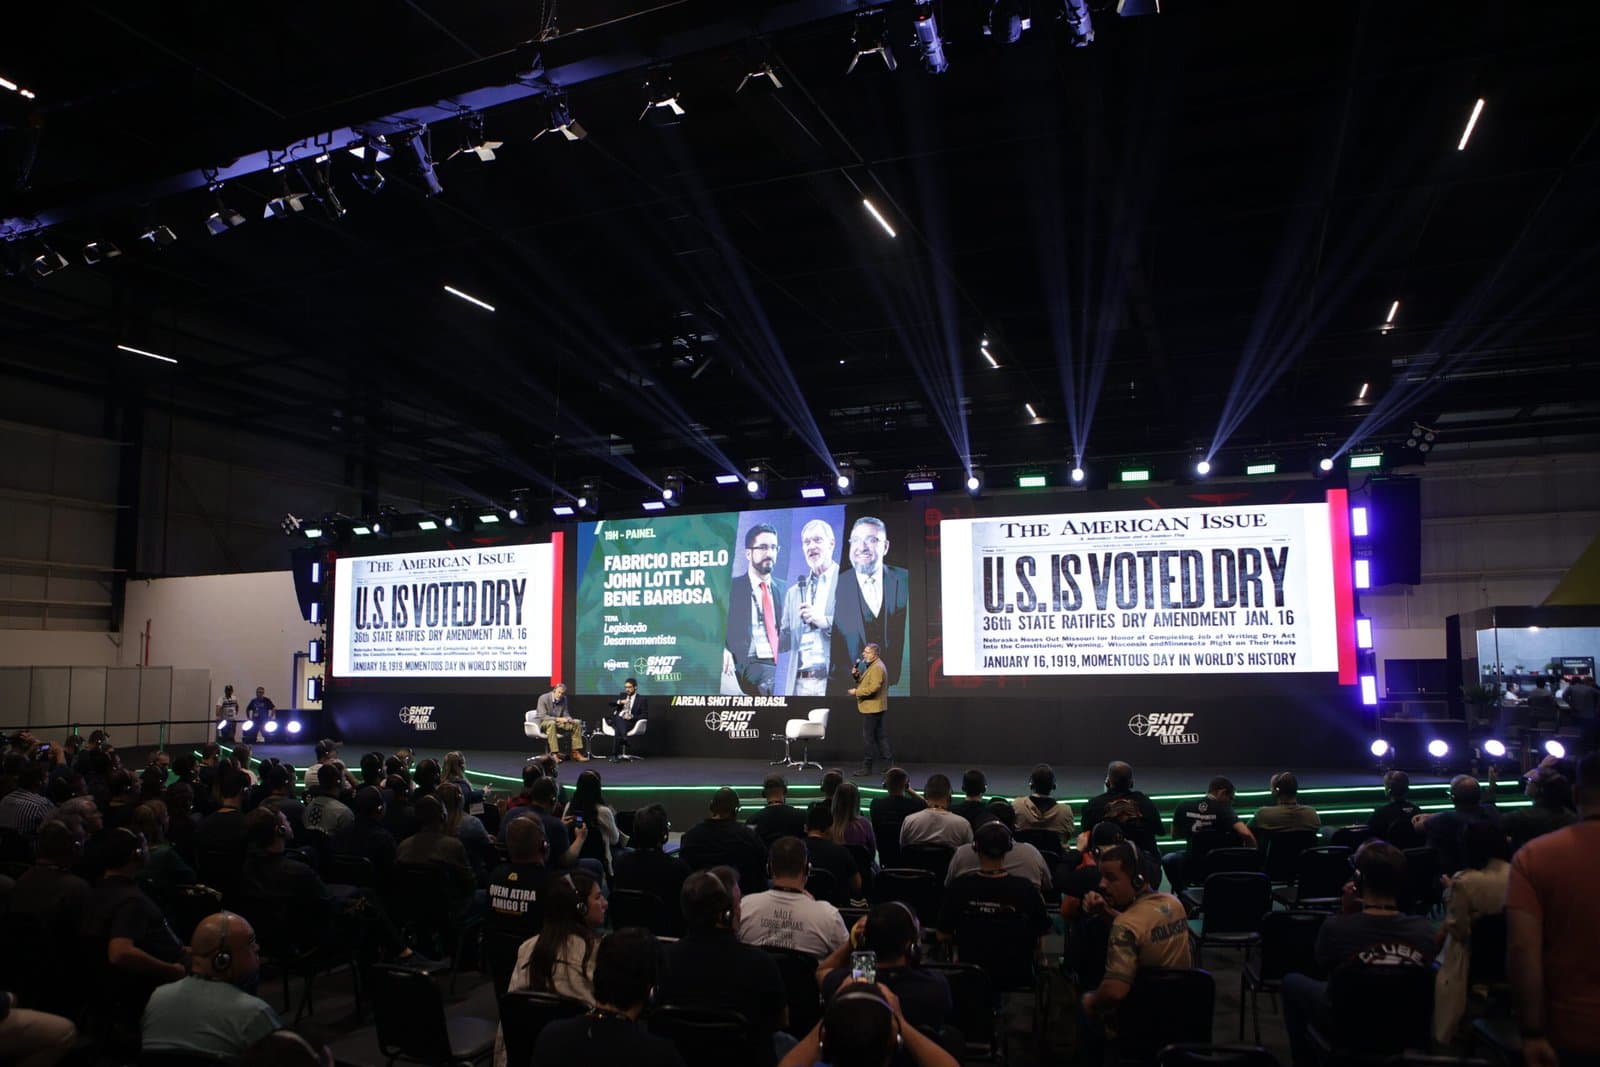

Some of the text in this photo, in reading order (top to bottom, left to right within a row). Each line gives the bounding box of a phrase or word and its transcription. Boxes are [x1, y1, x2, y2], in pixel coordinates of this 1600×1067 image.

[1000, 514, 1267, 538] THE AMERICAN ISSUE
[626, 528, 656, 540] PAINEL
[367, 560, 393, 573] THE
[398, 555, 472, 571] AMERICAN
[478, 552, 515, 566] ISSUE
[604, 550, 728, 571] FABRICIO REBELO
[604, 570, 706, 589] JOHN LOTT JR
[983, 546, 1289, 614] U.S. IS VOTED DRY
[356, 578, 527, 630] U.S. IS VOTED DRY
[604, 588, 713, 608] BENE BARBOSA
[983, 610, 1294, 630] 36th STATE RATIFIES DRY AMENDMENT JAN. 16
[604, 622, 648, 635] Legislação
[354, 631, 369, 643] 36th
[373, 630, 392, 642] STATE
[396, 630, 426, 642] RATIFIES
[429, 629, 444, 641] DRY
[446, 628, 493, 640] AMENDMENT
[518, 627, 527, 640] 16
[604, 634, 676, 646] Desarmamentista
[353, 661, 378, 672] JANUARY
[404, 660, 443, 671] MOMENTOUS
[444, 661, 457, 671] DAY
[459, 661, 466, 671] IN
[468, 661, 496, 671] WORLD'S
[498, 661, 527, 672] HISTORY
[646, 656, 682, 666] SHOT
[983, 656, 1030, 668] JANUARY
[1052, 654, 1080, 668] 1919,
[1082, 653, 1150, 668] MOMENTOUS
[1154, 653, 1175, 666] DAY
[1179, 653, 1190, 666] IN
[1195, 652, 1244, 666] WORLD'S
[1248, 652, 1296, 666] HISTORY
[646, 666, 673, 676] FAIR
[707, 696, 732, 706] SHOT
[732, 696, 754, 706] FAIR
[754, 696, 788, 706] BRASIL
[410, 706, 435, 716] SHOT
[720, 711, 756, 722] SHOT
[409, 716, 430, 724] FAIR
[1148, 713, 1194, 724] SHOT
[719, 722, 748, 732] FAIR
[1147, 725, 1184, 736] FAIR
[730, 730, 758, 738] BRASIL
[1162, 734, 1197, 744] BRASIL
[490, 884, 536, 902] QUEM ATIRA
[492, 898, 518, 912] AMIGO
